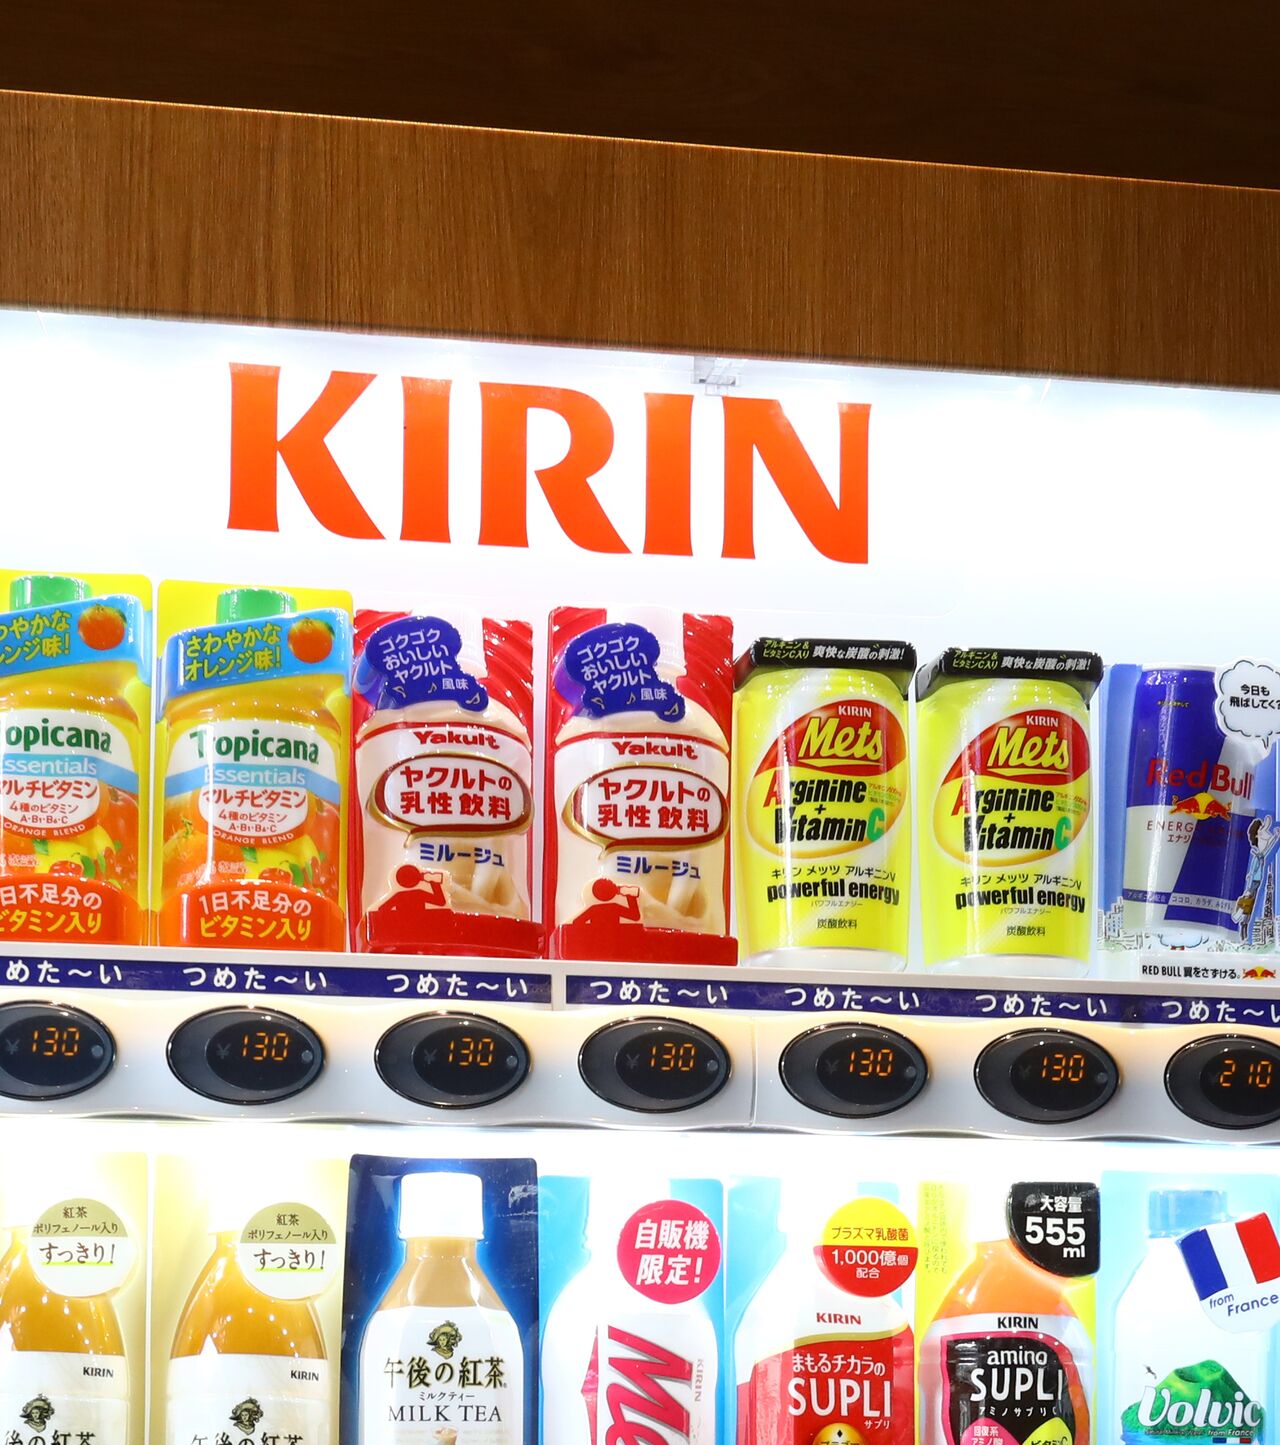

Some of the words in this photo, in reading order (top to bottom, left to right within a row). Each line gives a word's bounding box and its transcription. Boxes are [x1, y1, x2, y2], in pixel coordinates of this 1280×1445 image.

[227, 362, 872, 564] KIRIN
[379, 629, 441, 653] ゴクゴク
[383, 644, 449, 669] おいしい
[1240, 684, 1270, 696] 今日も
[838, 705, 872, 717] KIRIN
[413, 730, 500, 749] Yakult
[800, 718, 885, 760] Mets
[987, 728, 1069, 770] Mets
[400, 767, 512, 791] ヤクルトの
[763, 770, 868, 807] Arginine
[1146, 759, 1207, 788] Red
[1209, 764, 1252, 800] Bull
[10, 802, 79, 814] 4種のビタミン
[401, 793, 511, 820] 乳性飲料
[4, 823, 47, 836] ORANGE
[53, 824, 85, 835] BLEND
[419, 843, 505, 866] ミルージュ
[767, 878, 846, 901] powerful
[848, 879, 900, 905] energy
[817, 918, 857, 929] 炭酸飲料
[1142, 965, 1159, 976] RED
[1161, 965, 1182, 977] BULL
[242, 1033, 289, 1061] 130
[649, 1044, 696, 1071] 130
[1220, 1060, 1272, 1088] 210
[63, 1206, 88, 1219] 紅茶
[1040, 1194, 1082, 1213] 大容量
[635, 1220, 709, 1251] 自販機
[831, 1227, 909, 1241] プラズマ乳酸菌
[1025, 1216, 1086, 1246] 555
[1063, 1244, 1086, 1259] ml
[1209, 1294, 1235, 1310] from
[1226, 1293, 1280, 1317] France
[816, 1312, 862, 1325] KIRIN
[997, 1316, 1039, 1330] KIRIN
[792, 1353, 885, 1376] まもるチカラの
[987, 1344, 1048, 1368] amino
[82, 1366, 114, 1377] KIRIN
[383, 1356, 505, 1390] 午後の紅茶
[418, 1391, 475, 1401] ミルクティー
[969, 1367, 1063, 1402] SUPLI
[788, 1377, 891, 1418] SUPLI
[1137, 1386, 1263, 1429] Volvic
[387, 1403, 452, 1423] MILK
[457, 1403, 503, 1423] TEA
